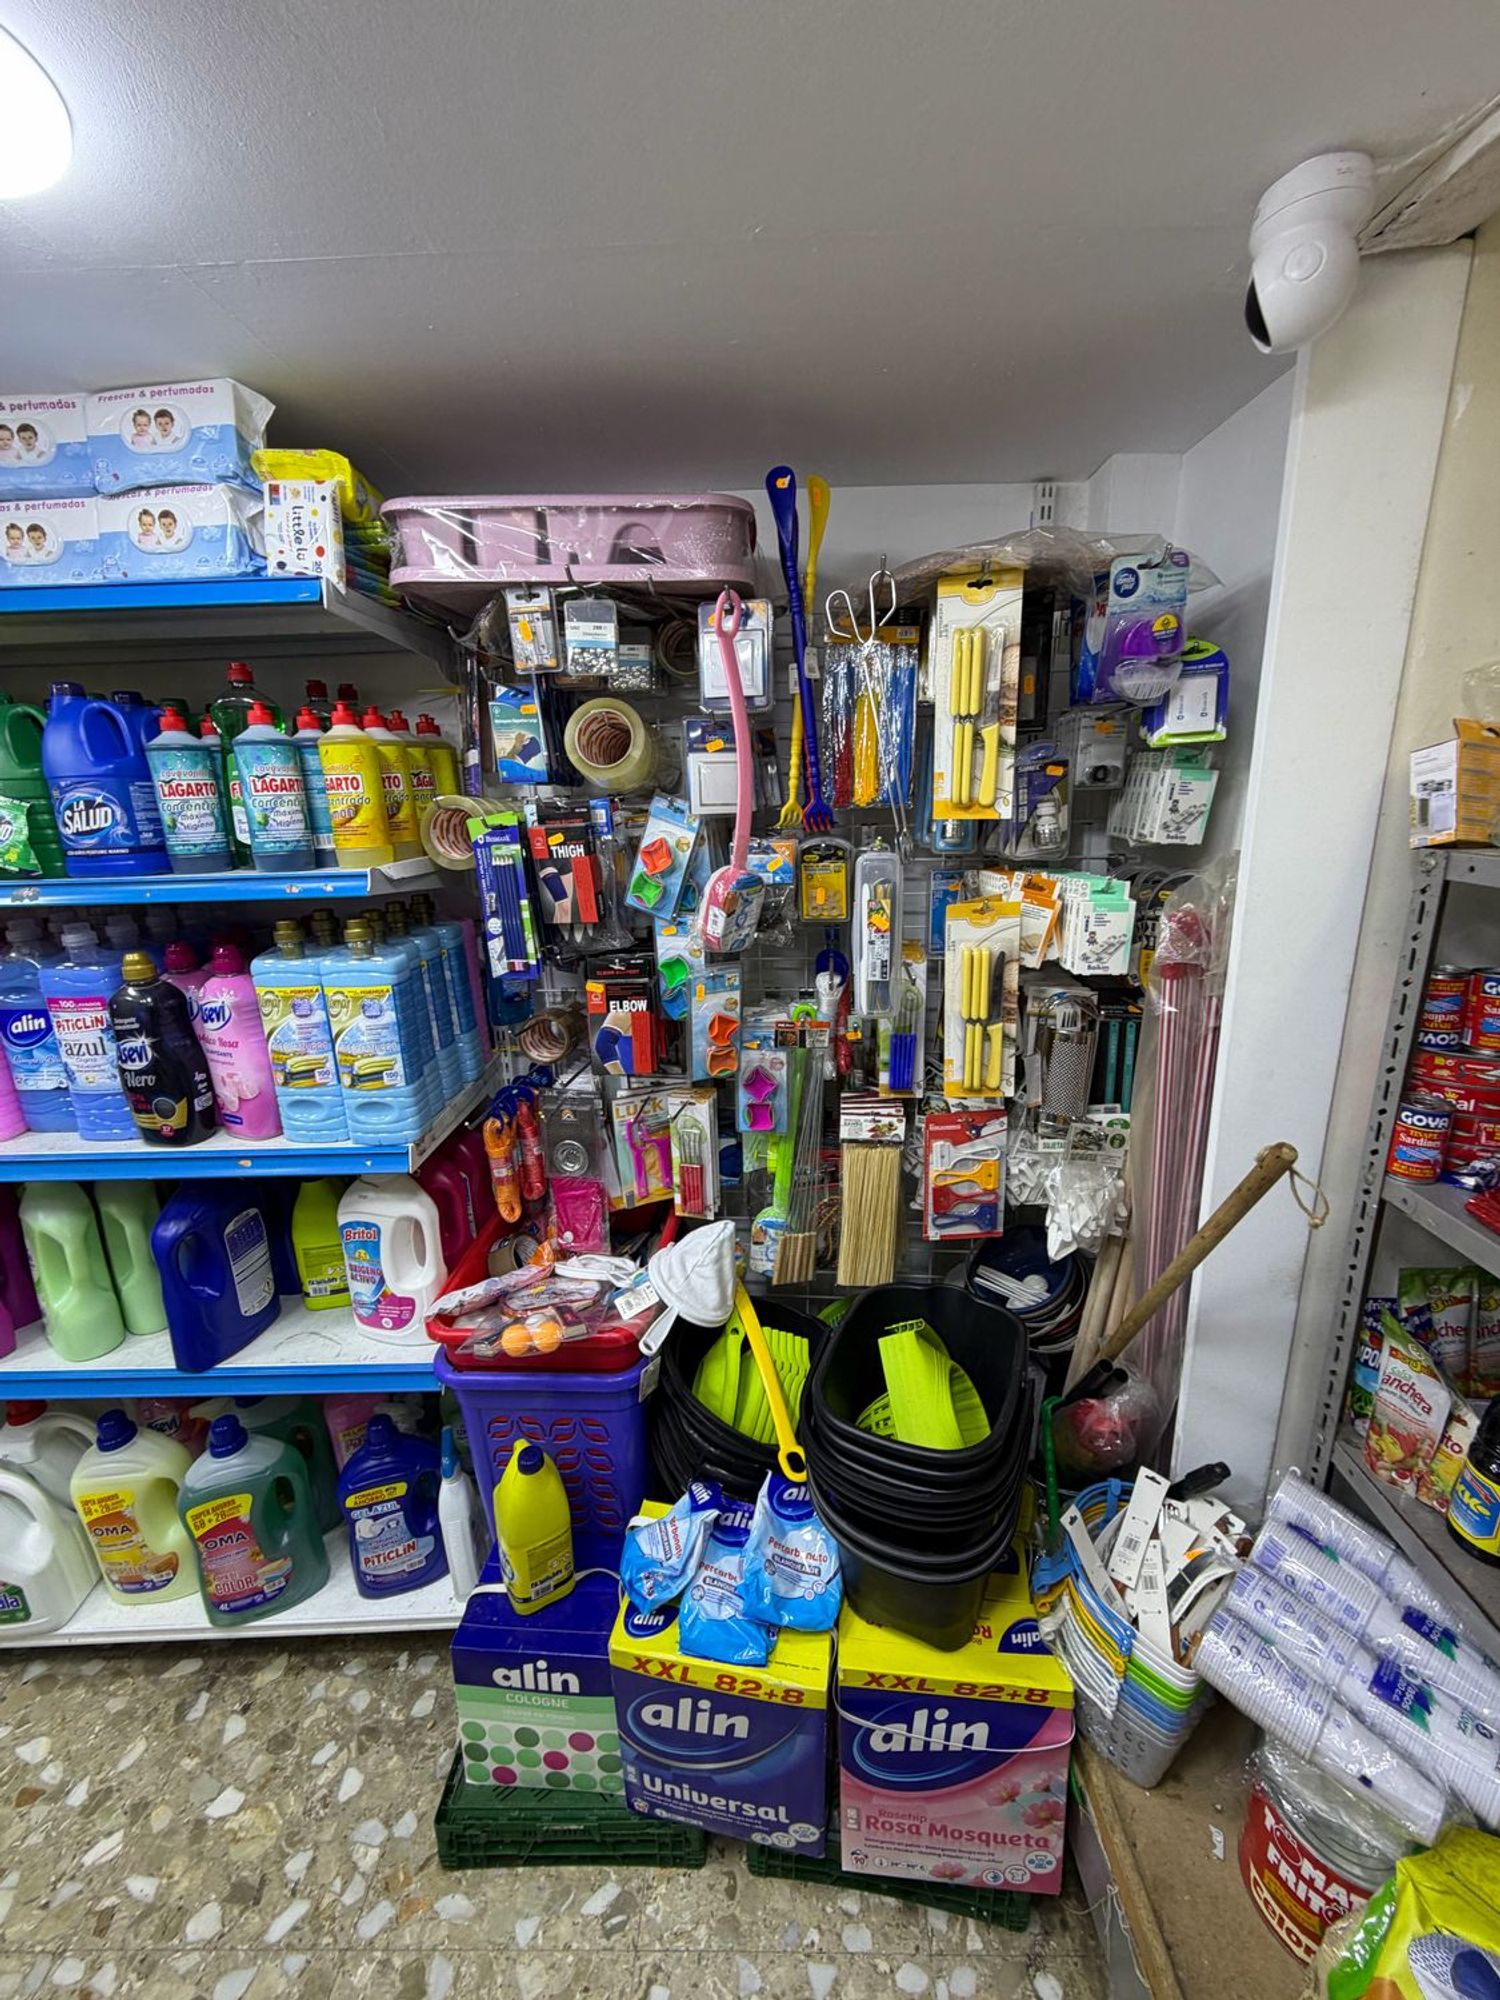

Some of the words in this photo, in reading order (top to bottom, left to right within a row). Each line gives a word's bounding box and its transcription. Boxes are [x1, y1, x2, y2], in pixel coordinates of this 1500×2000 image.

[150, 385, 215, 399] perfumadas
[9, 399, 77, 412] perfumadas
[24, 500, 86, 512] perfumadas
[160, 782, 217, 798] LAGARTO
[73, 800, 85, 811] LA
[64, 806, 113, 834] SALUD
[551, 845, 585, 858] THIGH
[609, 1000, 648, 1013] ELBOW
[11, 1014, 46, 1034] alin
[64, 1037, 107, 1056] azul
[124, 1072, 156, 1087] Nero
[1401, 1111, 1449, 1128] GOYA
[345, 1228, 377, 1241] Britol
[351, 1507, 372, 1519] GEL
[374, 1501, 400, 1513] AZUL
[93, 1525, 132, 1537] OMA
[204, 1532, 247, 1550] OMA
[215, 1575, 254, 1594] COLOR
[633, 1612, 665, 1627] alin
[492, 1659, 580, 1694] alin
[632, 1656, 698, 1686] XXL
[714, 1673, 806, 1706] 82+8
[863, 1673, 936, 1693] XXL
[953, 1682, 1050, 1704] 82+8
[505, 1693, 569, 1709] COLOGNE
[640, 1698, 750, 1739] alin
[869, 1708, 989, 1753] alin
[642, 1773, 790, 1824] Universal
[878, 1808, 928, 1824] Rosehip
[865, 1815, 922, 1836] Rosa
[928, 1823, 1050, 1848] Mosqueta
